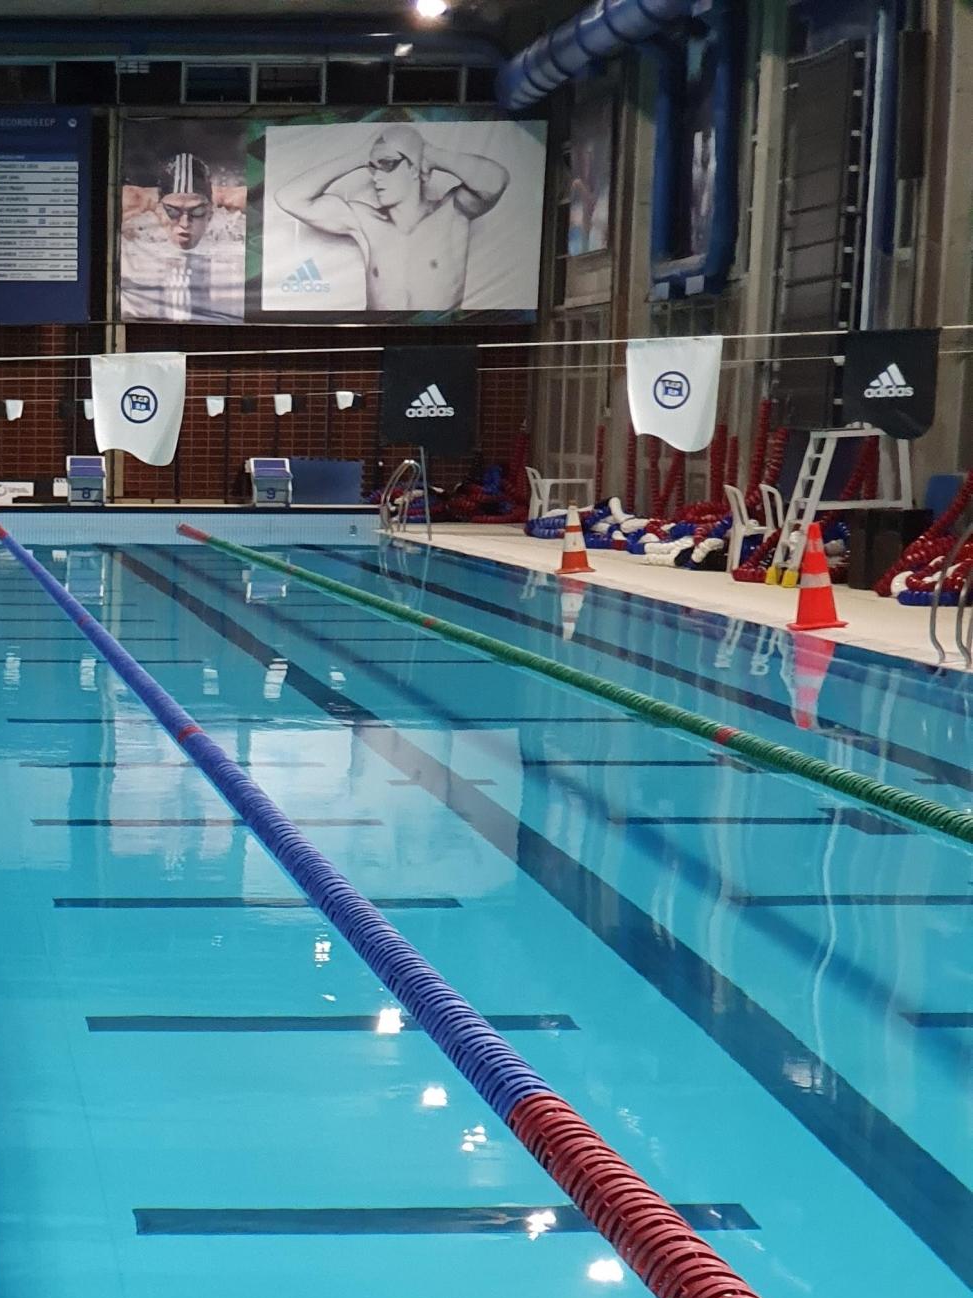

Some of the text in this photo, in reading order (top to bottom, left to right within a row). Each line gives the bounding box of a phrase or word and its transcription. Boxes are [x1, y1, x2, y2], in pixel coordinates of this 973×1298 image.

[281, 281, 330, 293] adidas
[864, 385, 914, 398] adidas
[405, 405, 455, 418] adidas
[266, 488, 276, 500] 9
